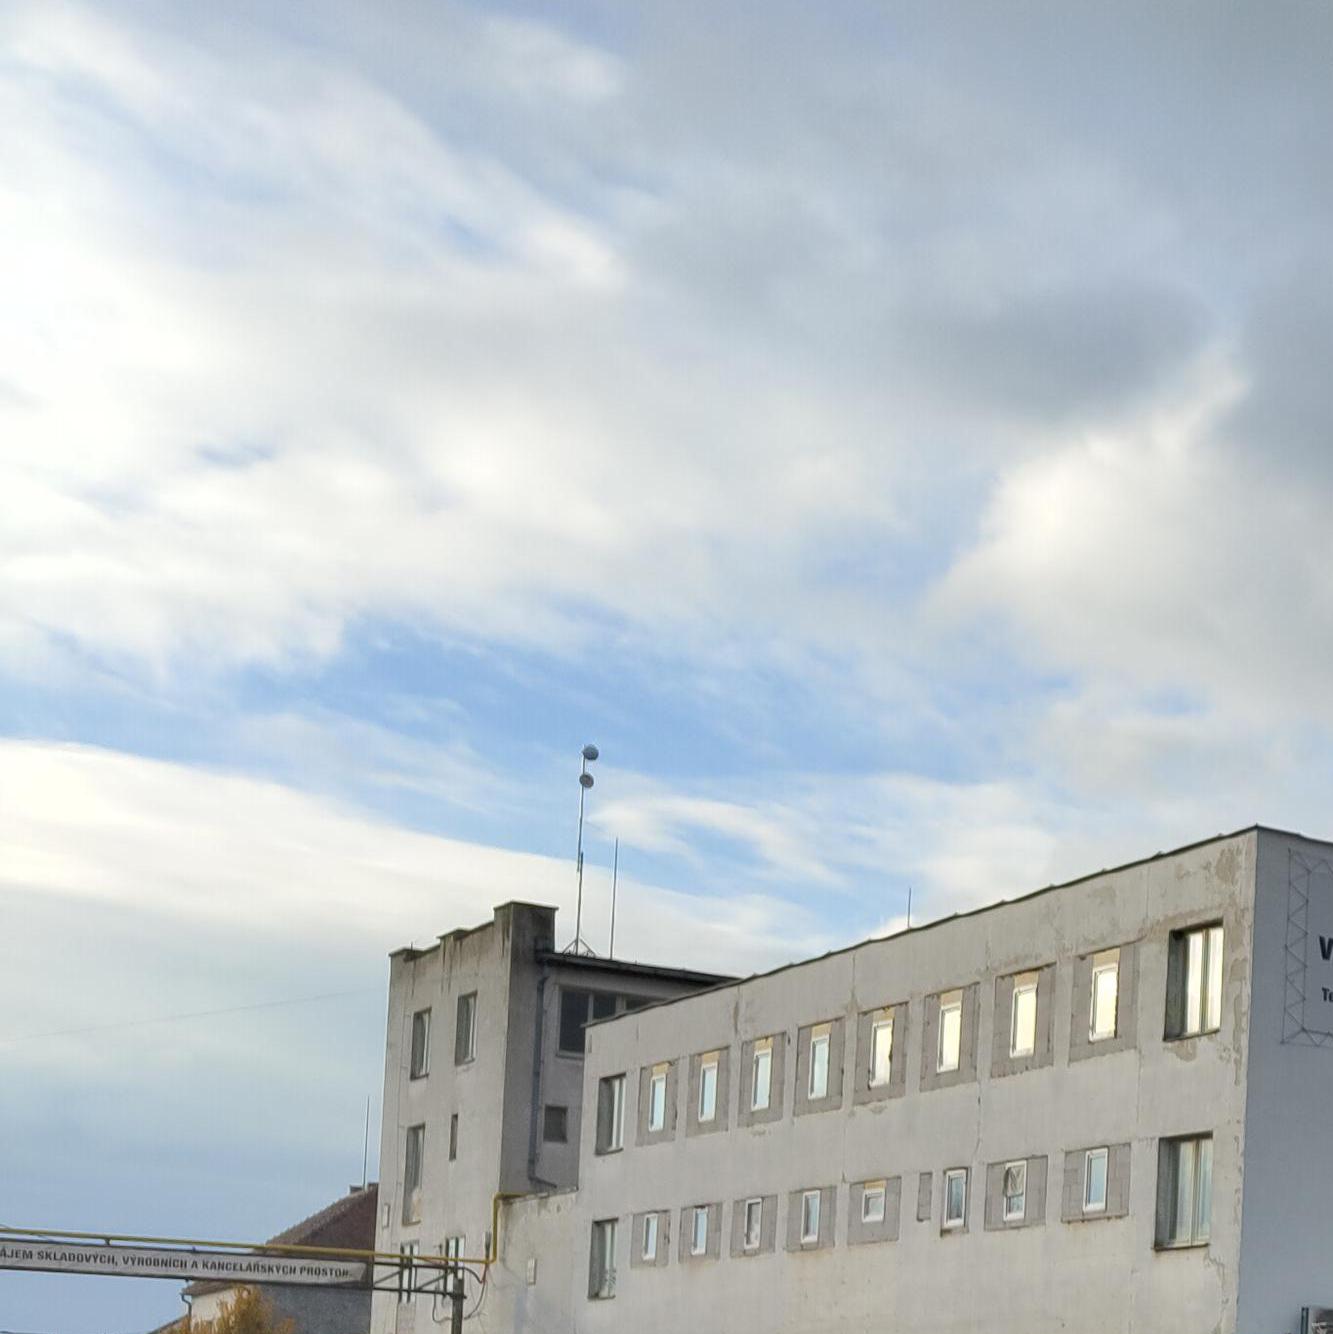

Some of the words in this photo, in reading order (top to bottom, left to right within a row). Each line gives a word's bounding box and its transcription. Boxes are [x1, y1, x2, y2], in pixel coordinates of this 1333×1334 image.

[37, 1248, 118, 1266] SKLADOVÝCH,
[122, 1254, 187, 1269] VÝROBNÍCH
[191, 1260, 198, 1269] A
[202, 1260, 297, 1277] KANCELÁŘSKÝCH
